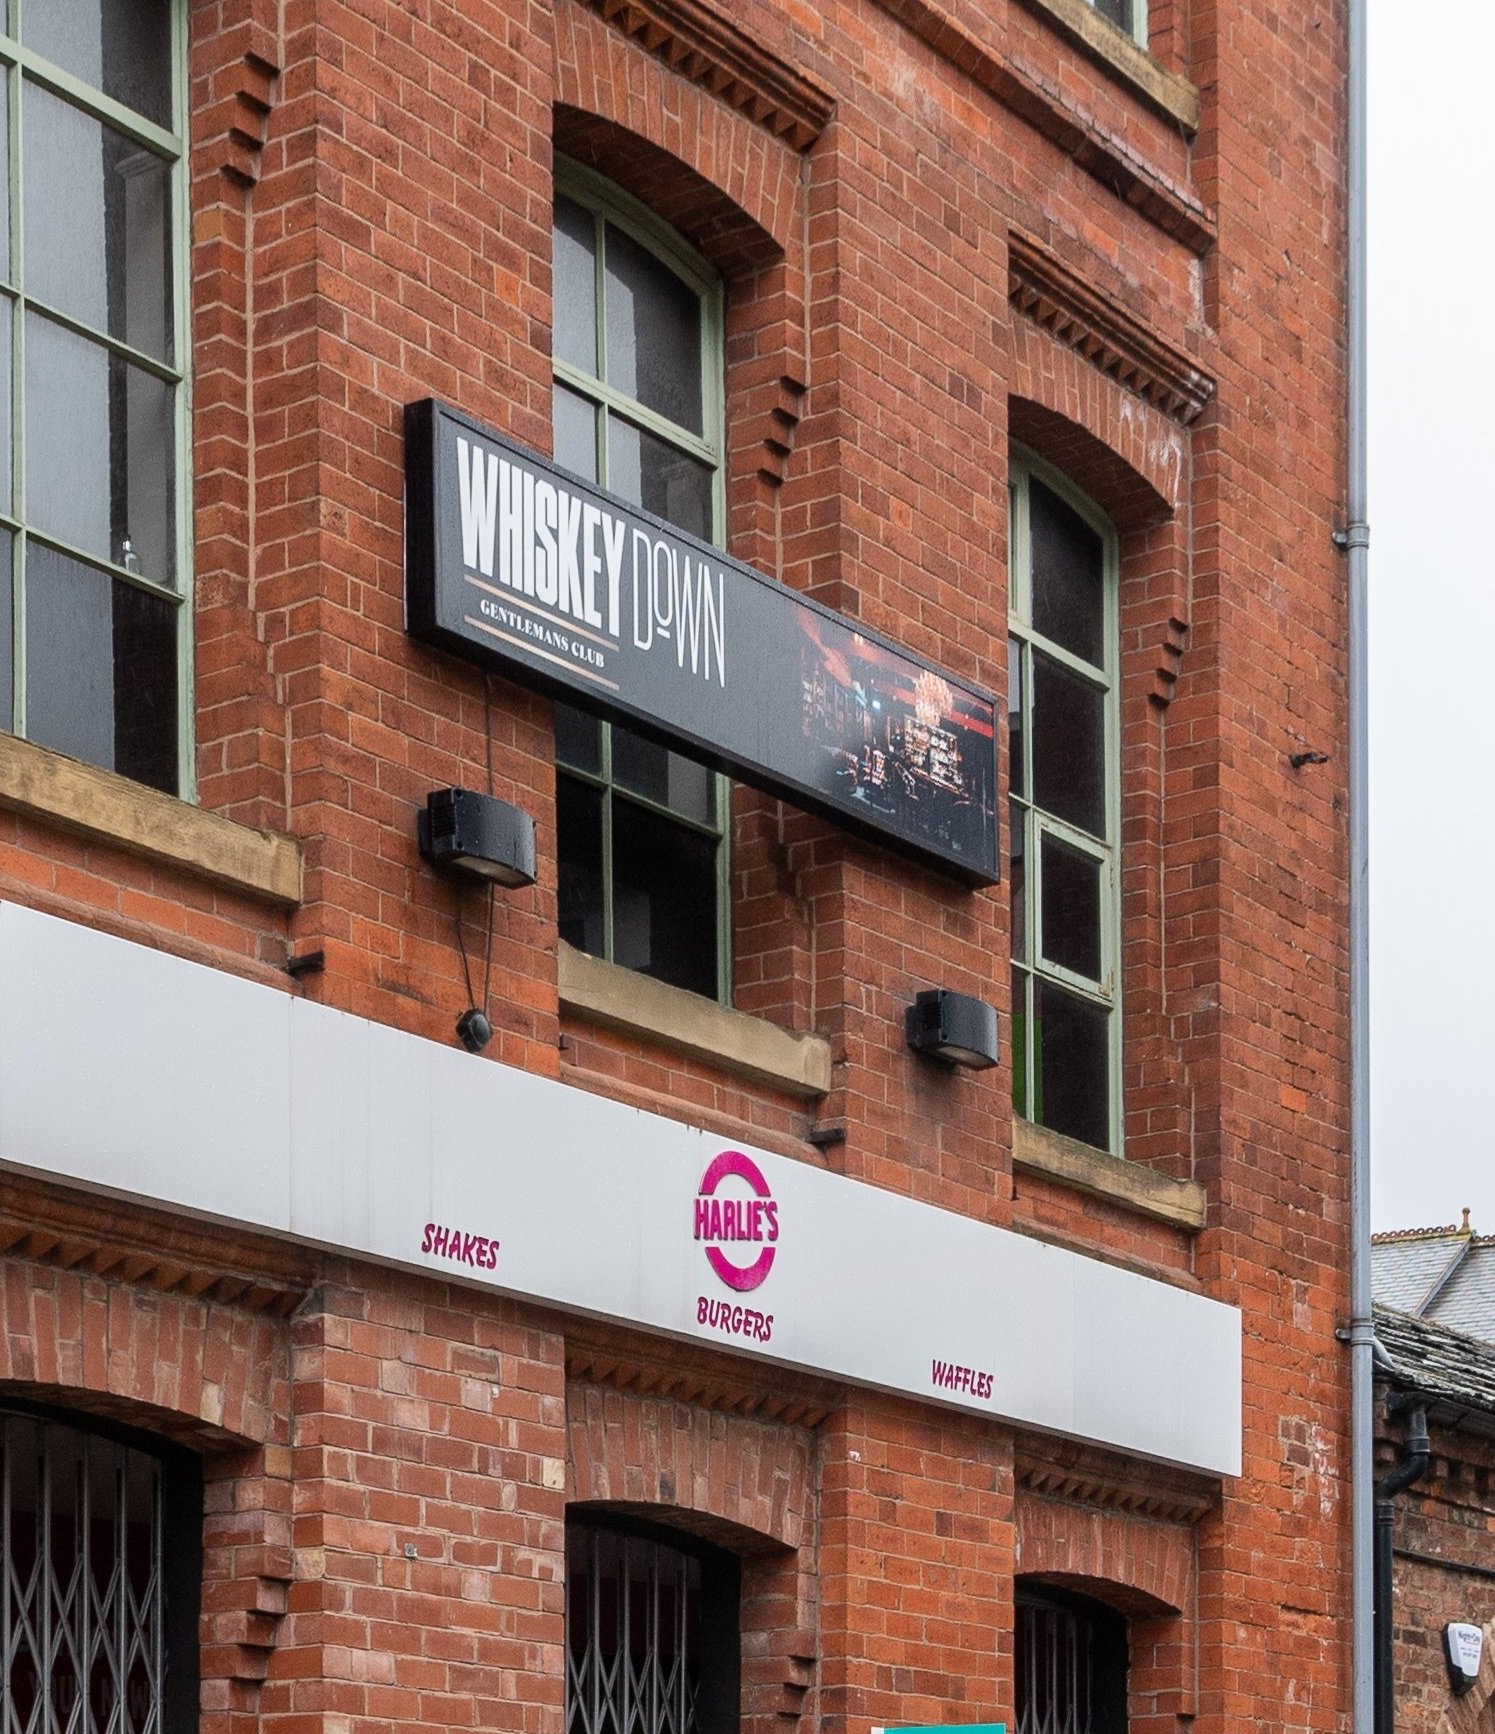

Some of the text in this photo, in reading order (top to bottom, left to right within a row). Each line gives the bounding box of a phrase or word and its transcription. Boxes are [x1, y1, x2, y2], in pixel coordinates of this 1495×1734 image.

[457, 436, 725, 688] WHISKEY DOWN
[480, 599, 605, 668] GENTLEMANS CLUB
[693, 1198, 779, 1242] HARLIE'S
[421, 1223, 500, 1270] SHAKES
[696, 1296, 774, 1343] BURGERS
[932, 1359, 994, 1400] WAFFLES
